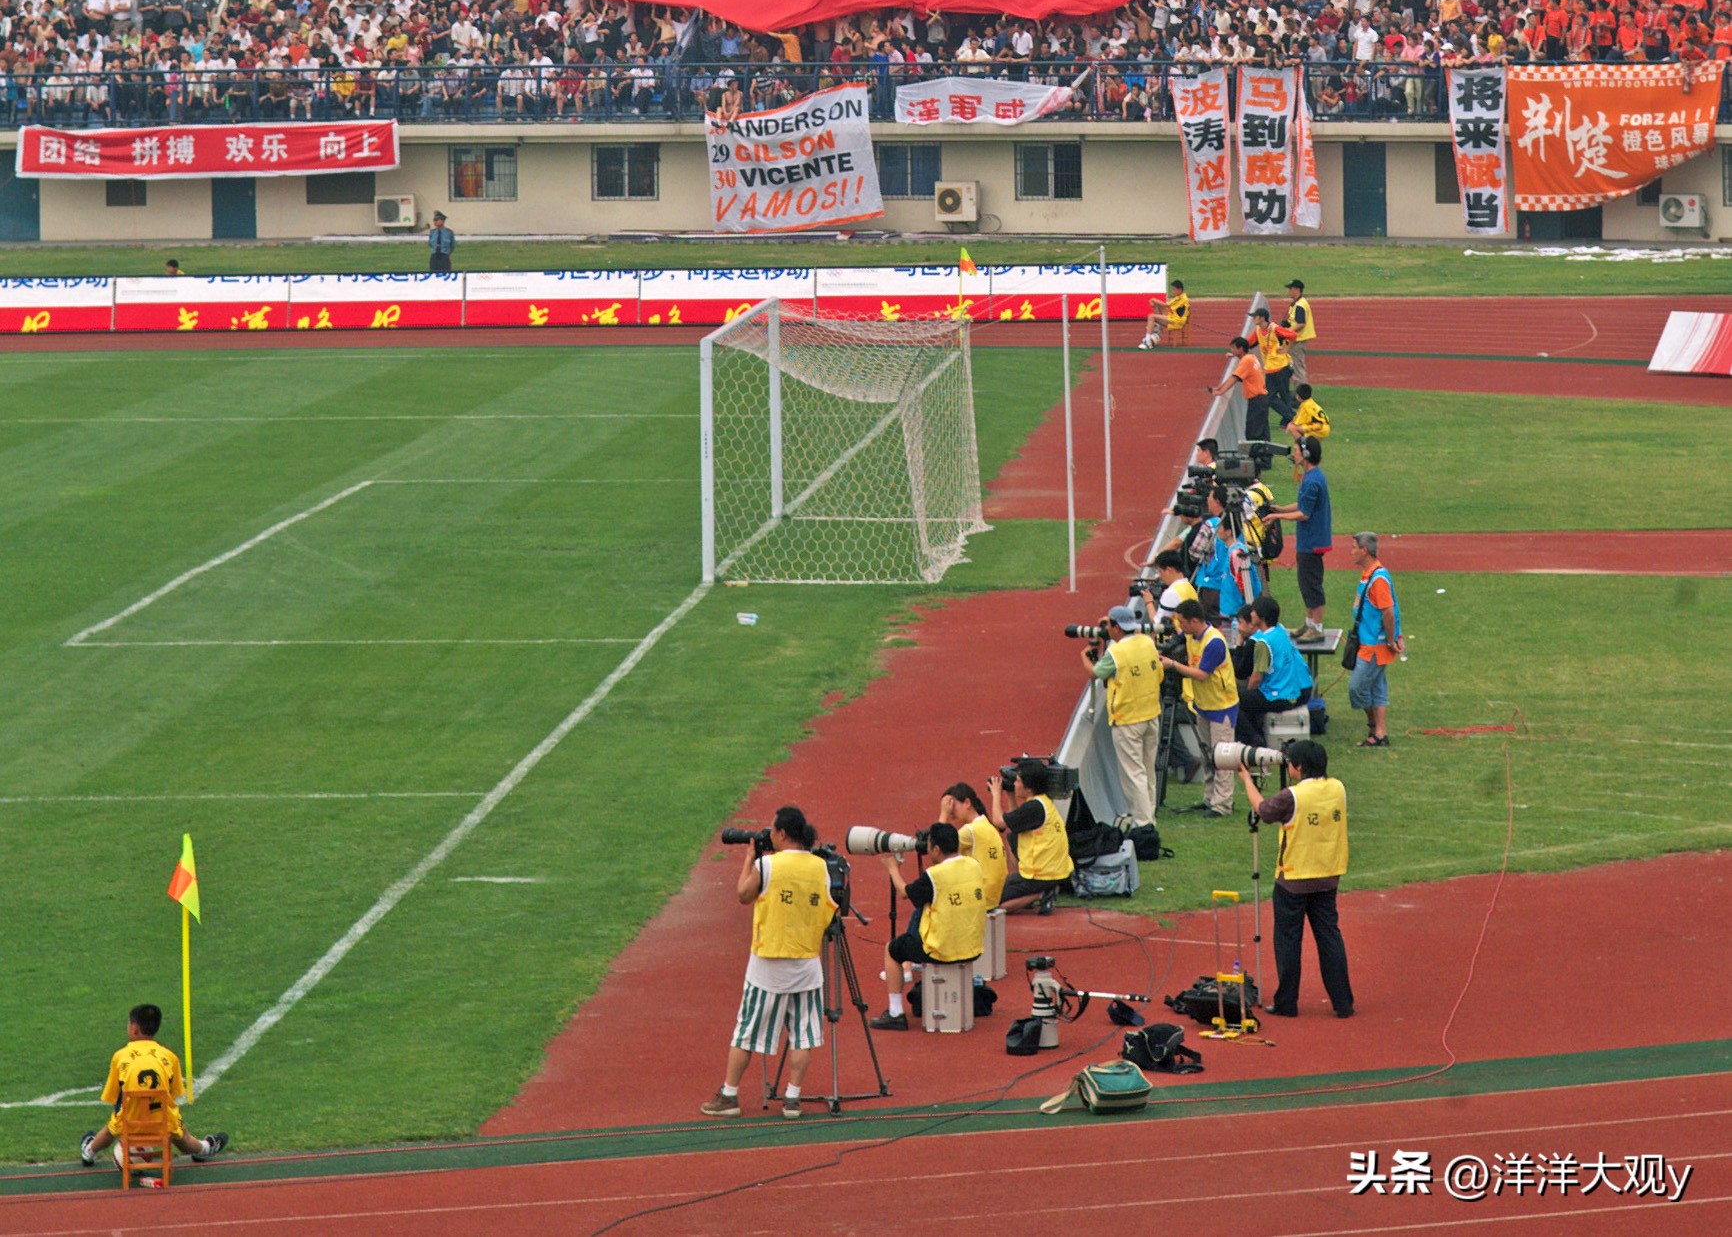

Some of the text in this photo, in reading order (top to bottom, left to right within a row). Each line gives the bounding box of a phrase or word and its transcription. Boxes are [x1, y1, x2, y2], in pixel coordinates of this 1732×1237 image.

[730, 99, 863, 138] ANDERSON
[38, 131, 382, 166] 团结 拼搏 欢乐 向上
[711, 129, 836, 163] 29 GILSON
[1242, 76, 1288, 224] 马到成功
[713, 152, 855, 190] 30 VICENTE
[716, 174, 864, 223] VAMOS!!
[1307, 809, 1342, 826] 记者
[780, 889, 820, 907] 记者
[948, 888, 983, 906] 记者
